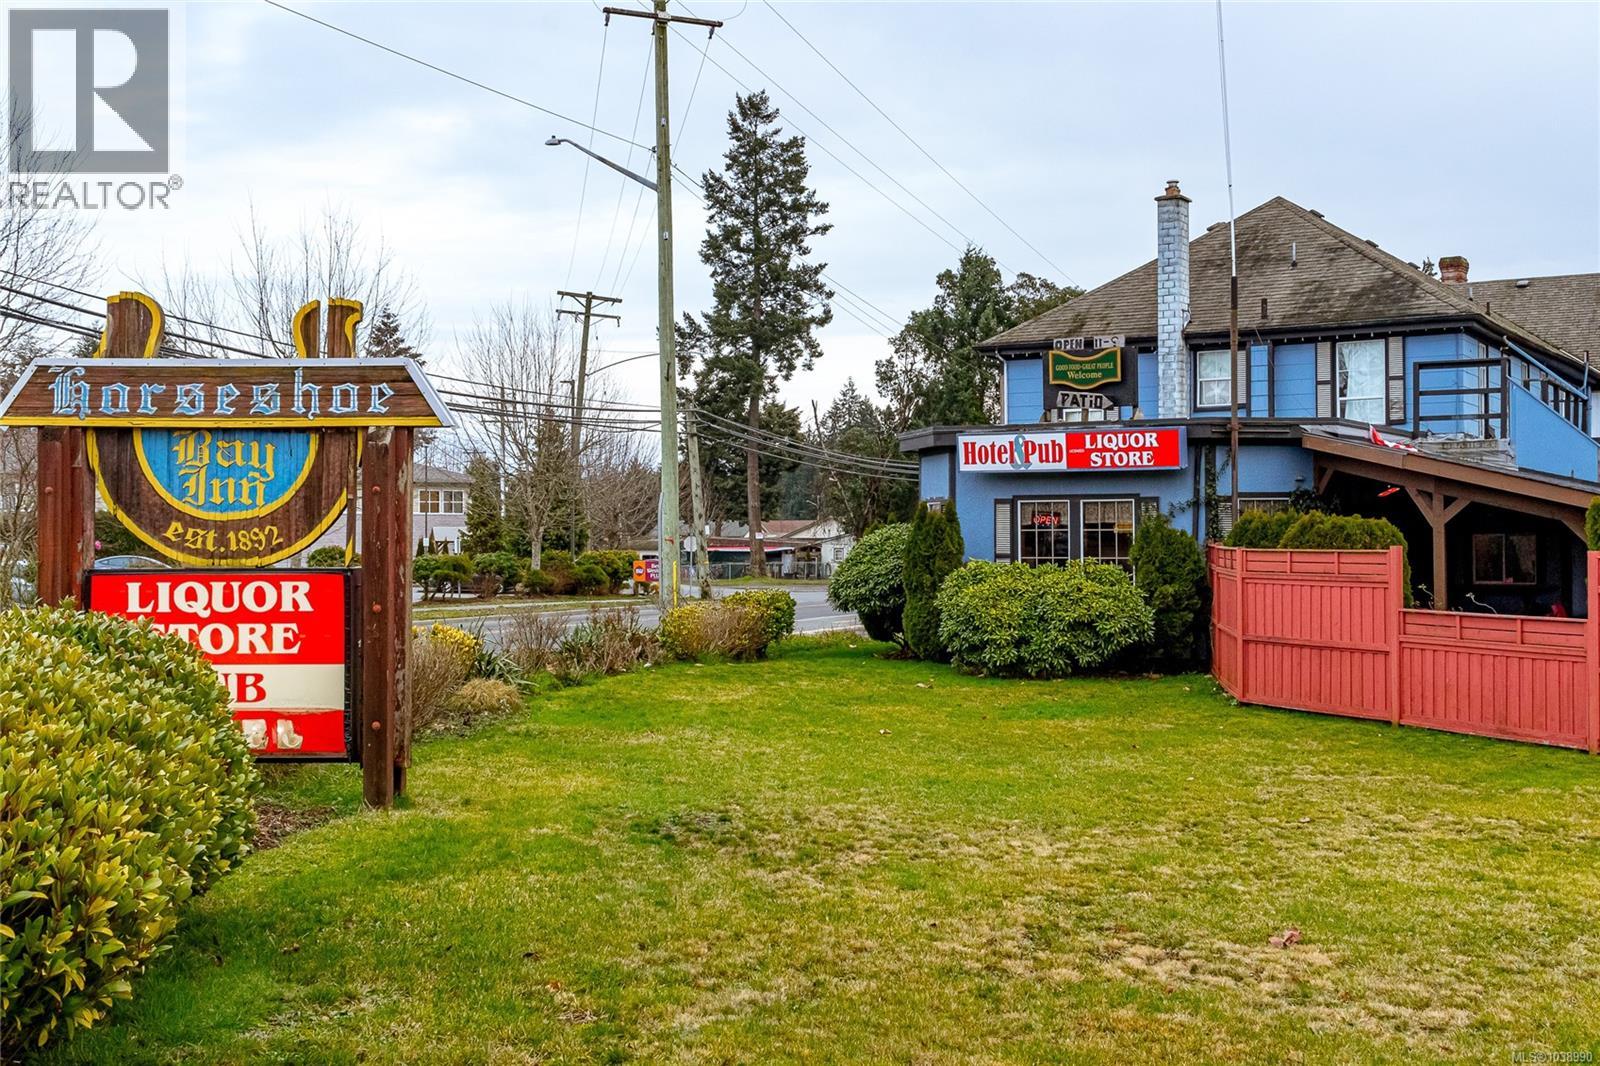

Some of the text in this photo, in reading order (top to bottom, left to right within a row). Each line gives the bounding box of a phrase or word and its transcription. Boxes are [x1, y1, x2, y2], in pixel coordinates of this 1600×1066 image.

[1055, 339, 1082, 350] OPEN
[1067, 371, 1103, 379] Welcome
[48, 366, 395, 419] Horseshoe
[1084, 432, 1159, 451] LIQUOR
[172, 430, 275, 481] Bay
[1090, 451, 1154, 467] STORE
[181, 464, 269, 506] Inn
[1033, 514, 1059, 525] OPEN
[126, 581, 314, 618] LIQUOR
